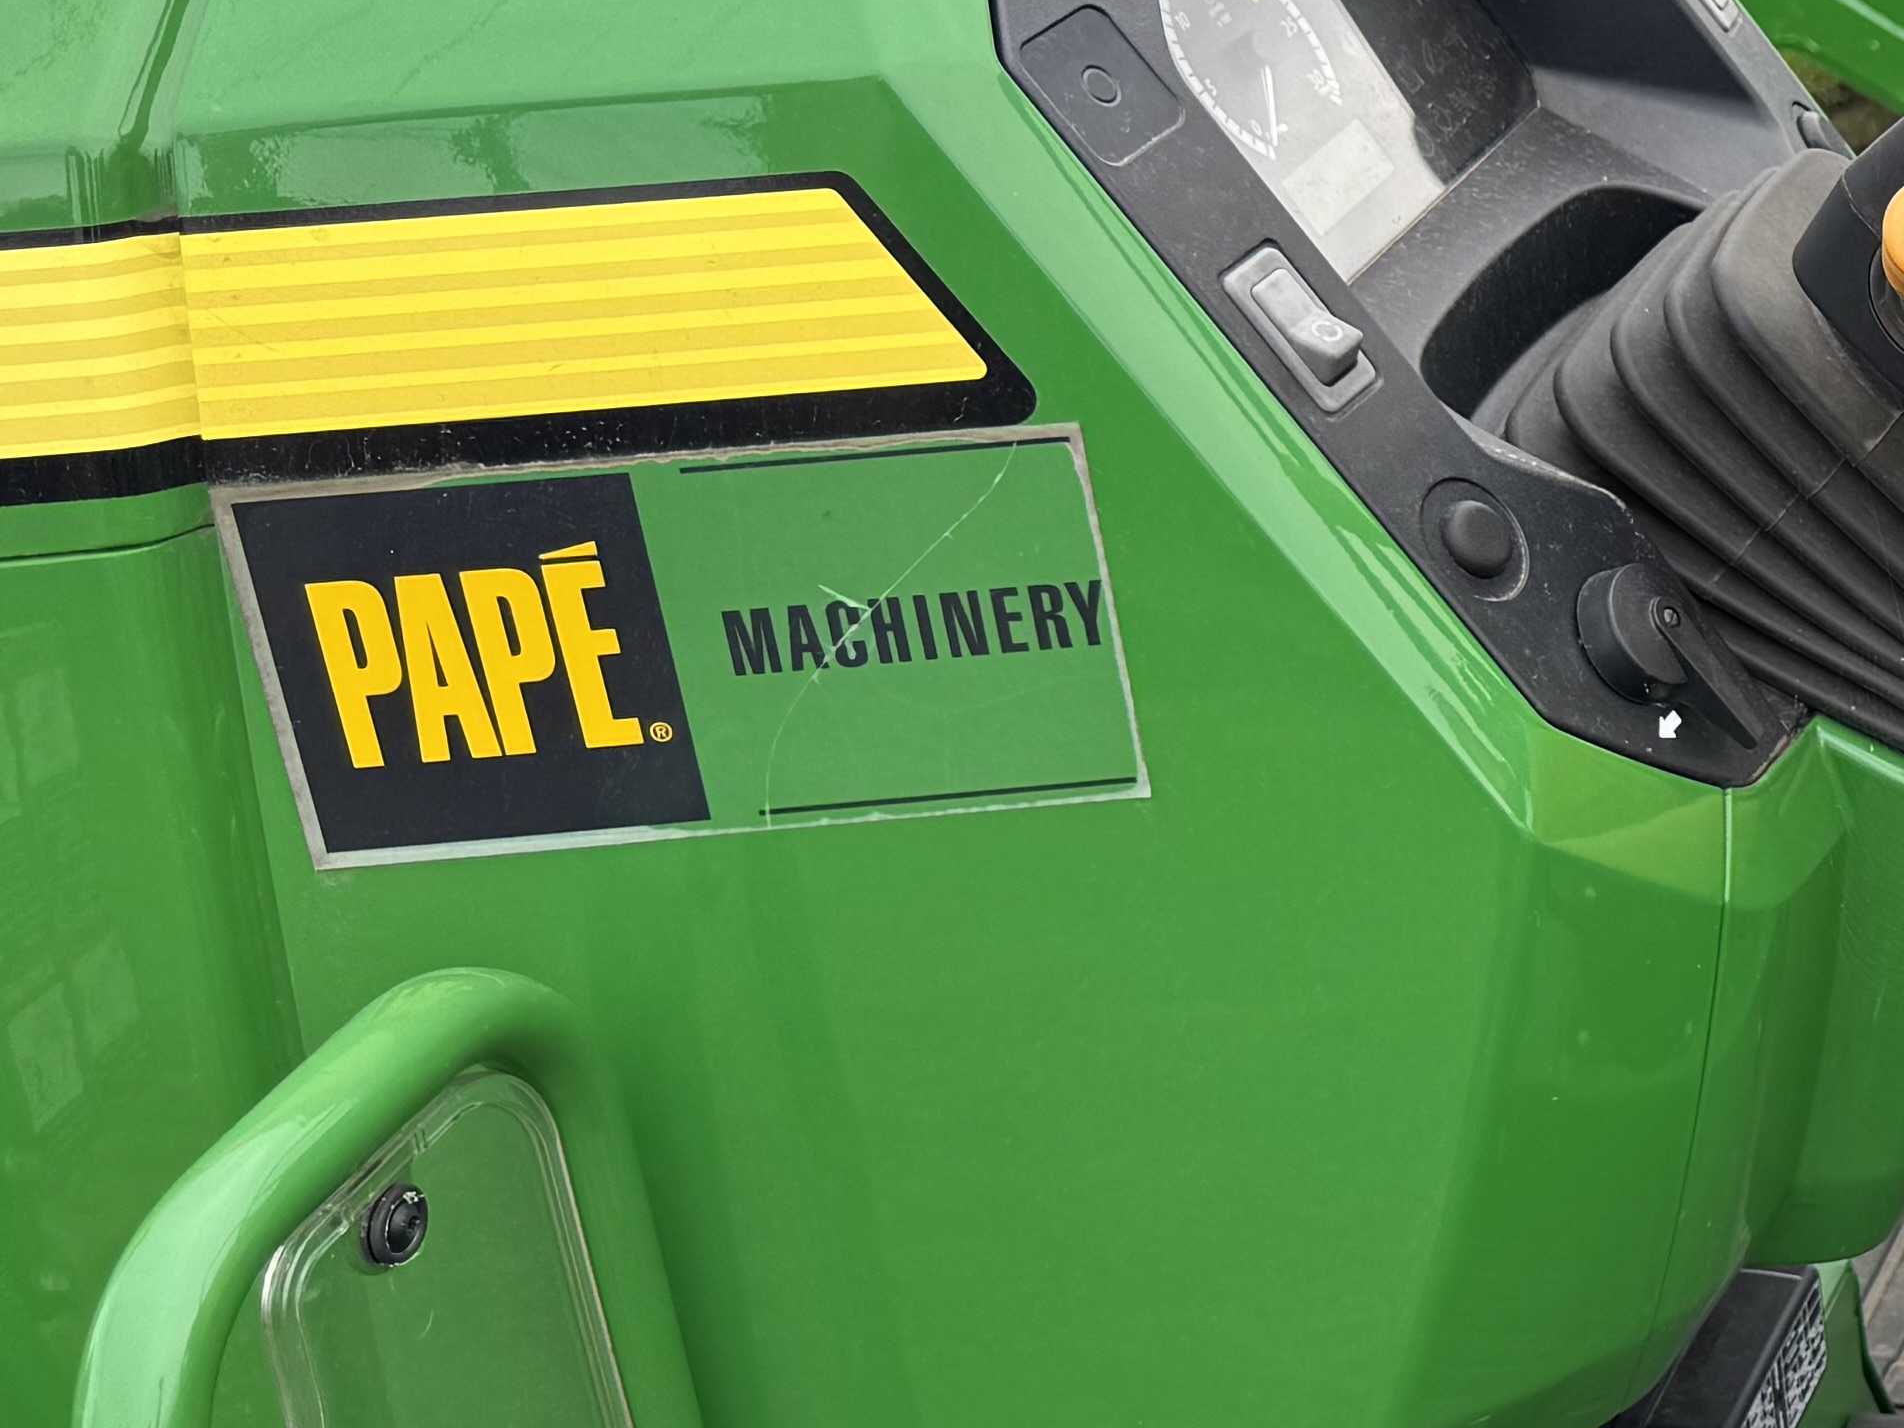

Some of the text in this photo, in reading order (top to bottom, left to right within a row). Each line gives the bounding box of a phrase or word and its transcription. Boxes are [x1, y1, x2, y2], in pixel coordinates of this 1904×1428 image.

[1173, 10, 1191, 32] 10
[1280, 15, 1298, 38] 25
[1204, 77, 1218, 97] 5
[1306, 68, 1324, 91] 30
[720, 578, 1104, 677] MACHINERY
